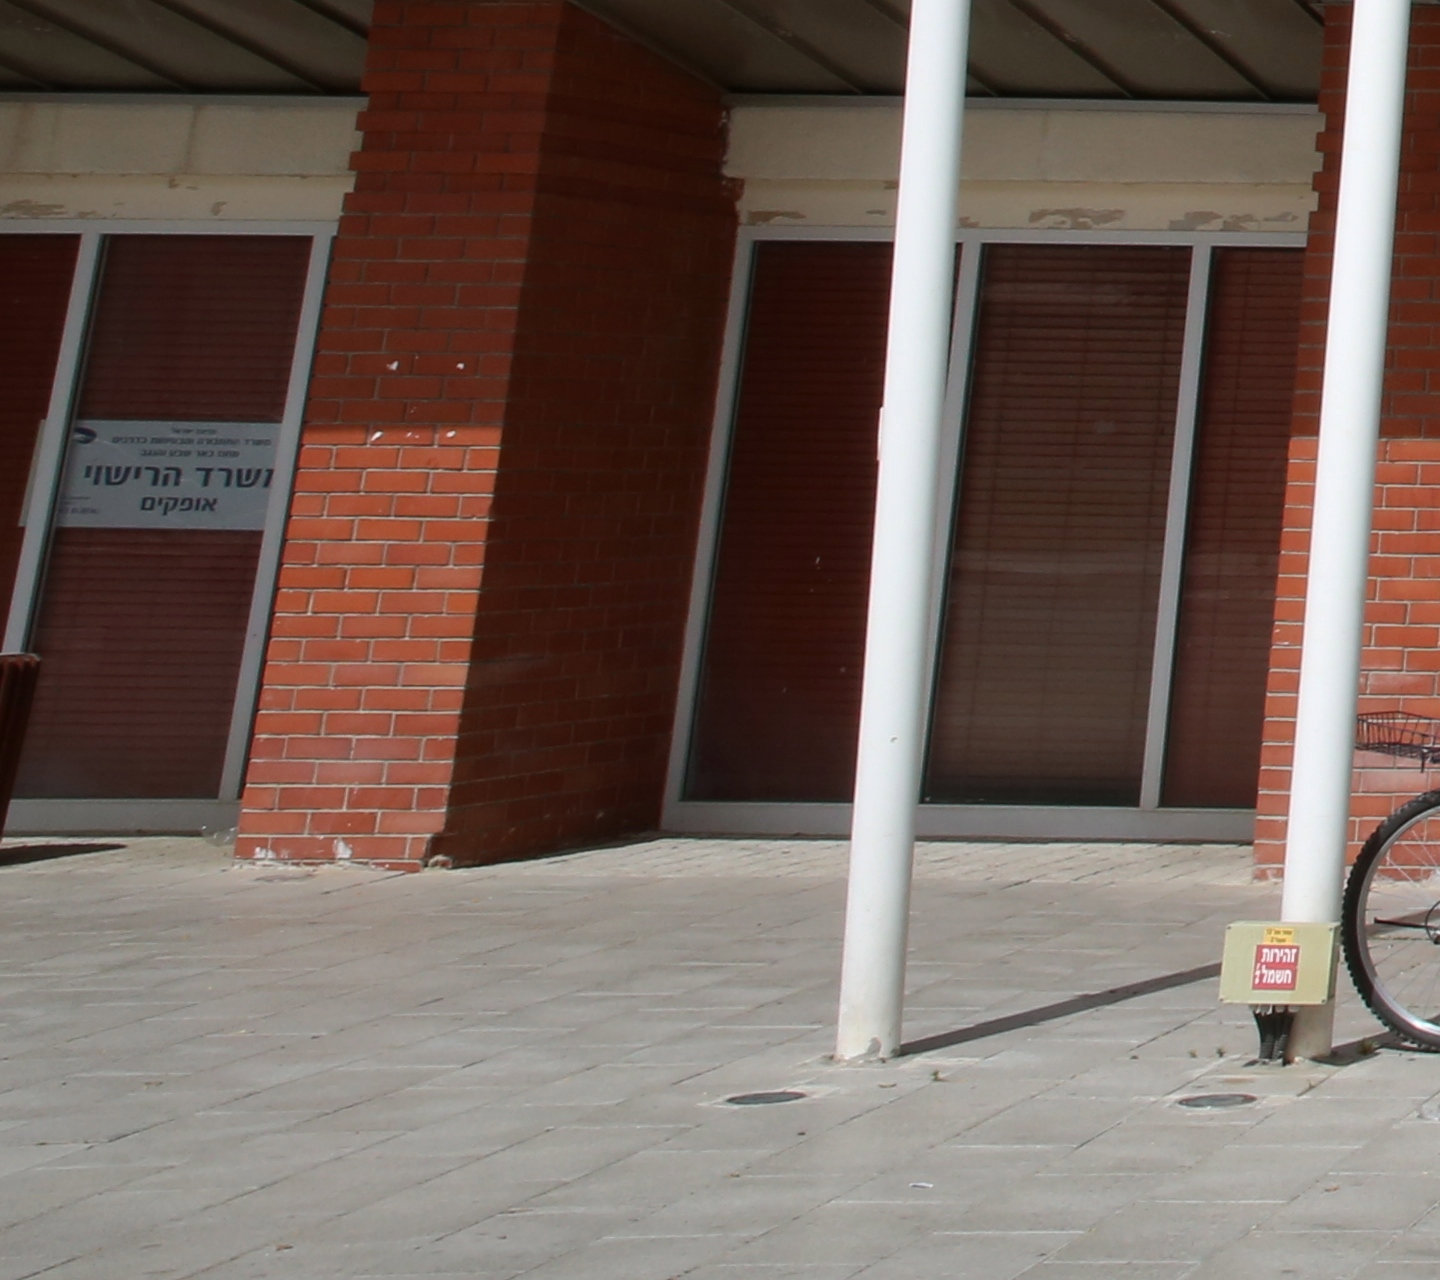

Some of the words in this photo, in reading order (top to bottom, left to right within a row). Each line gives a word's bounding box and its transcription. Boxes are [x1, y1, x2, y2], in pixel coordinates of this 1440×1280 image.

[84, 464, 182, 488] הרישוי
[140, 496, 219, 516] אופקים
[1260, 947, 1298, 964] זהירות
[1260, 964, 1293, 985] חשמל
